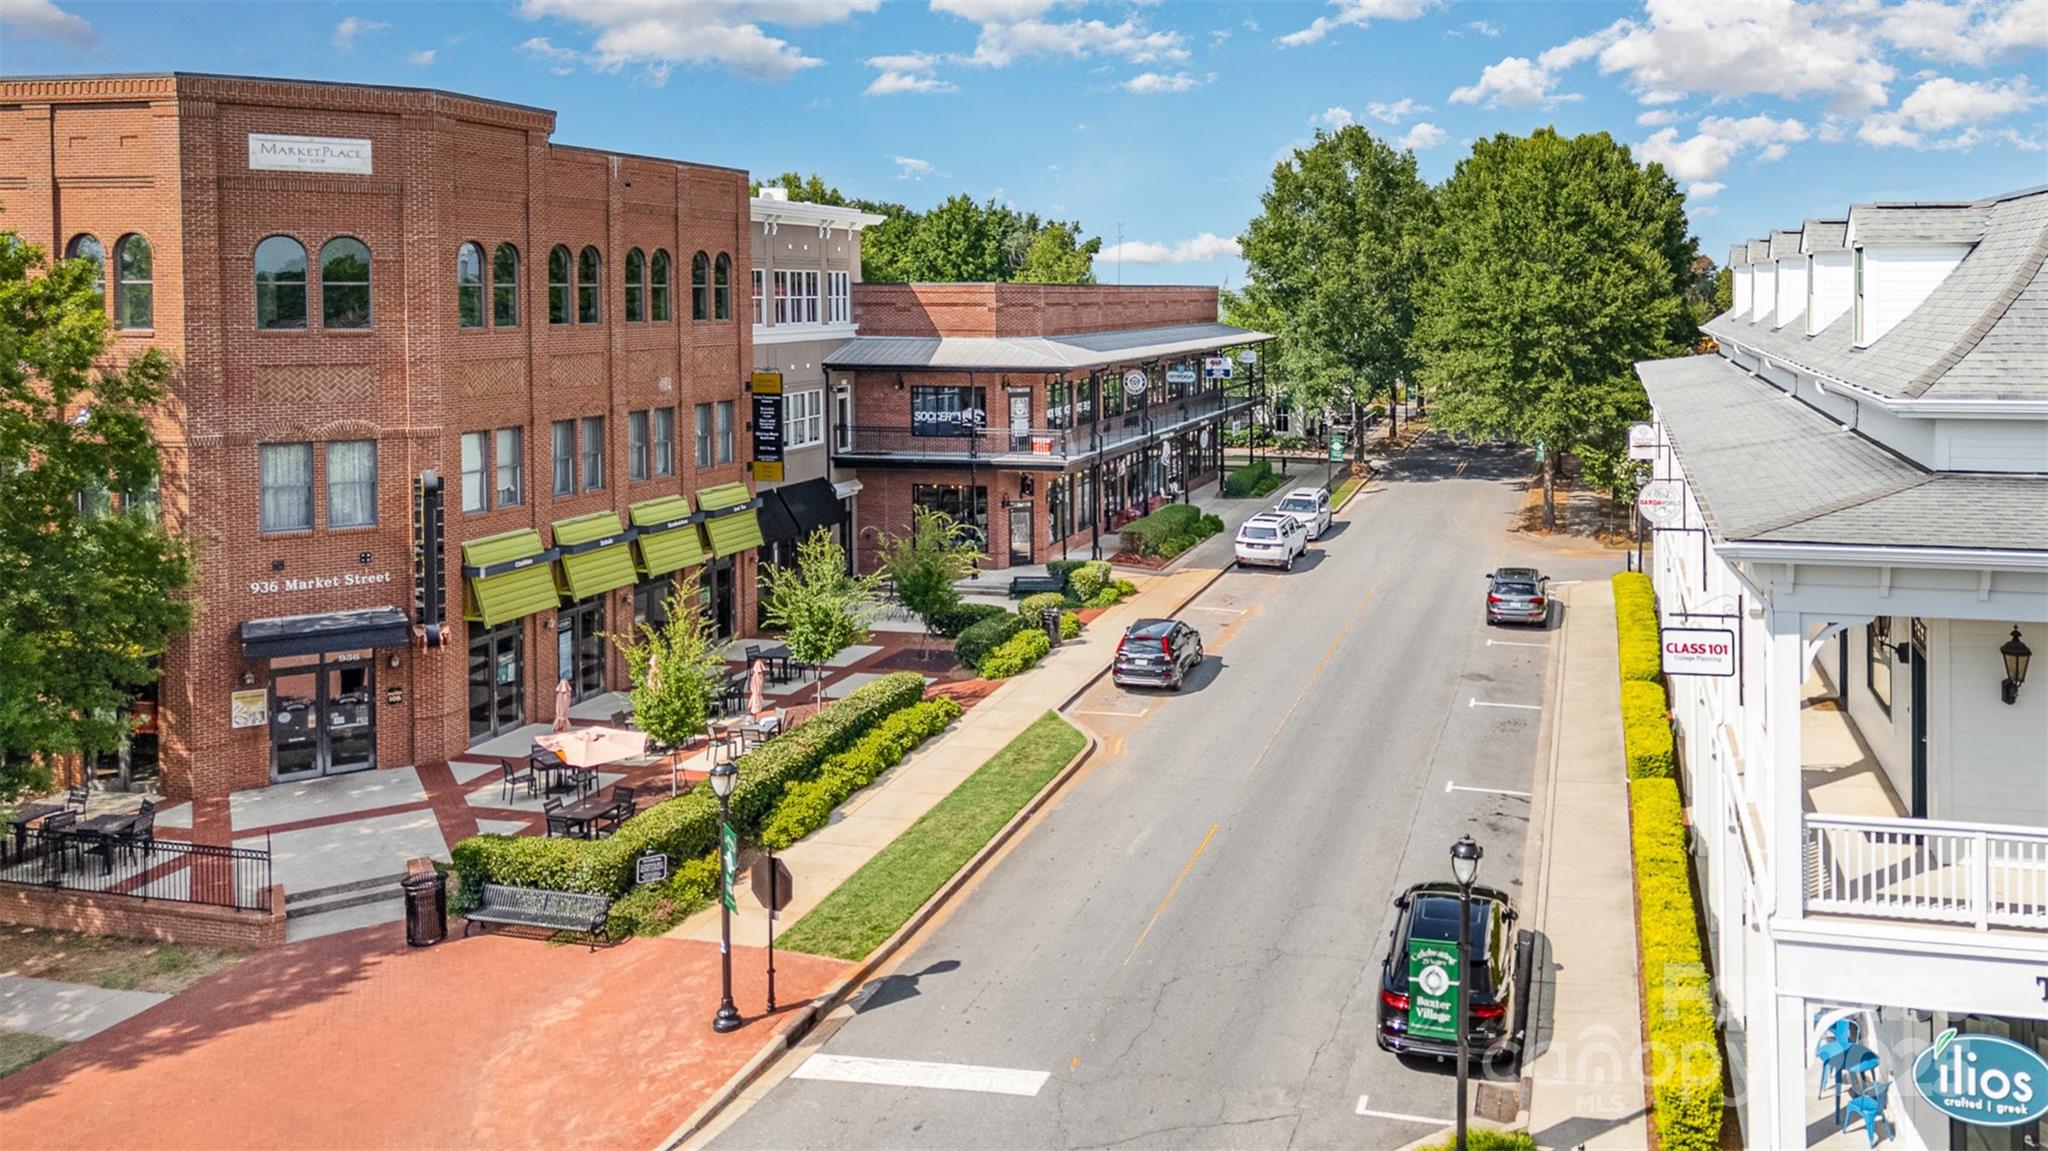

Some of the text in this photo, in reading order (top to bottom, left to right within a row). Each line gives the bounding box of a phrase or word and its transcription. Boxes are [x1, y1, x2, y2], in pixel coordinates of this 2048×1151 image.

[914, 410, 952, 422] SOCCER
[249, 571, 391, 594] 936 Market Street
[1666, 642, 1728, 655] CLASS 101
[1416, 995, 1452, 1010] Baxter
[1416, 1006, 1452, 1023] Village
[1939, 1044, 2033, 1103] ilios
[1943, 1097, 2028, 1116] crafted greek
